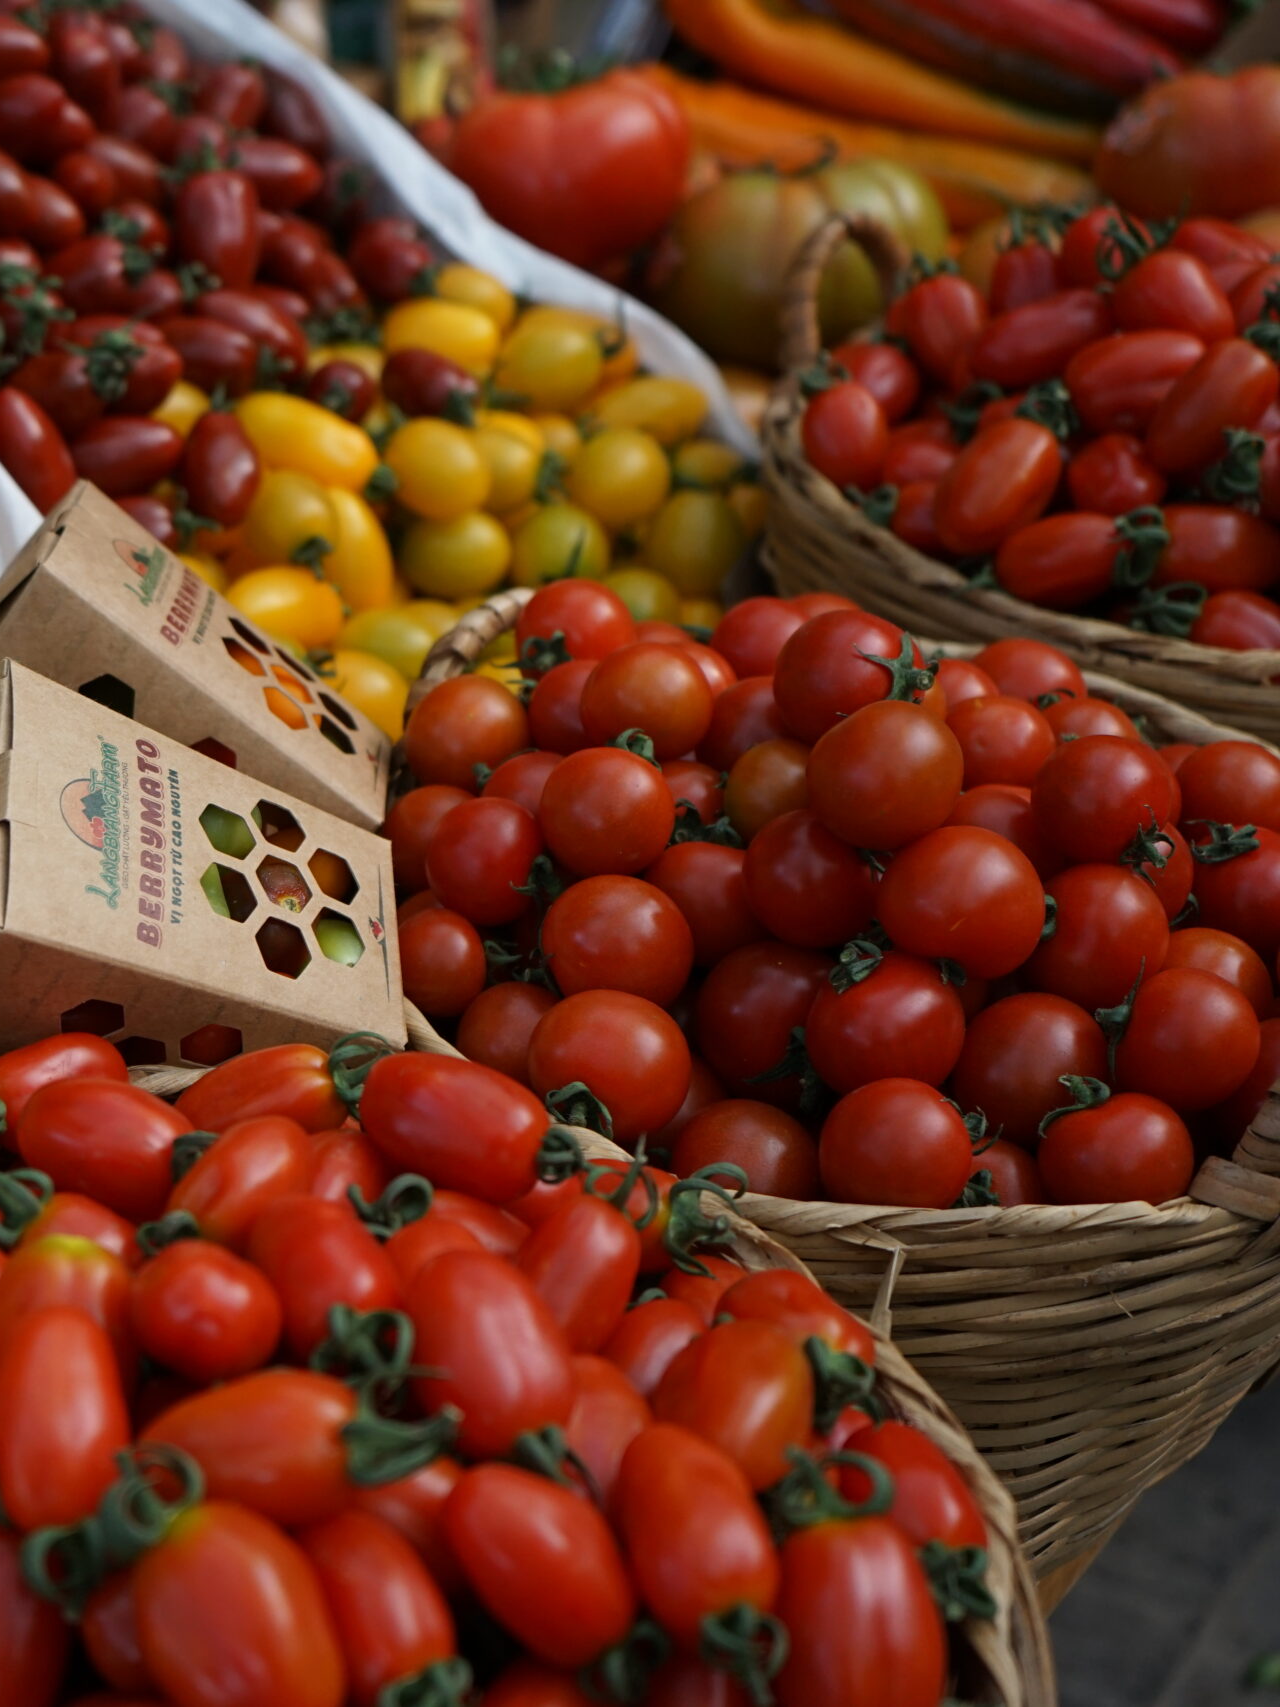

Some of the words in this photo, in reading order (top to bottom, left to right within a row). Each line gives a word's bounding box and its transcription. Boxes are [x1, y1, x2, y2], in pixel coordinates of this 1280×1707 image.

[167, 768, 183, 817] NGUYÊN
[135, 739, 166, 949] BERRYMATO
[170, 820, 183, 847] CAO
[170, 870, 185, 907] NGỌT
